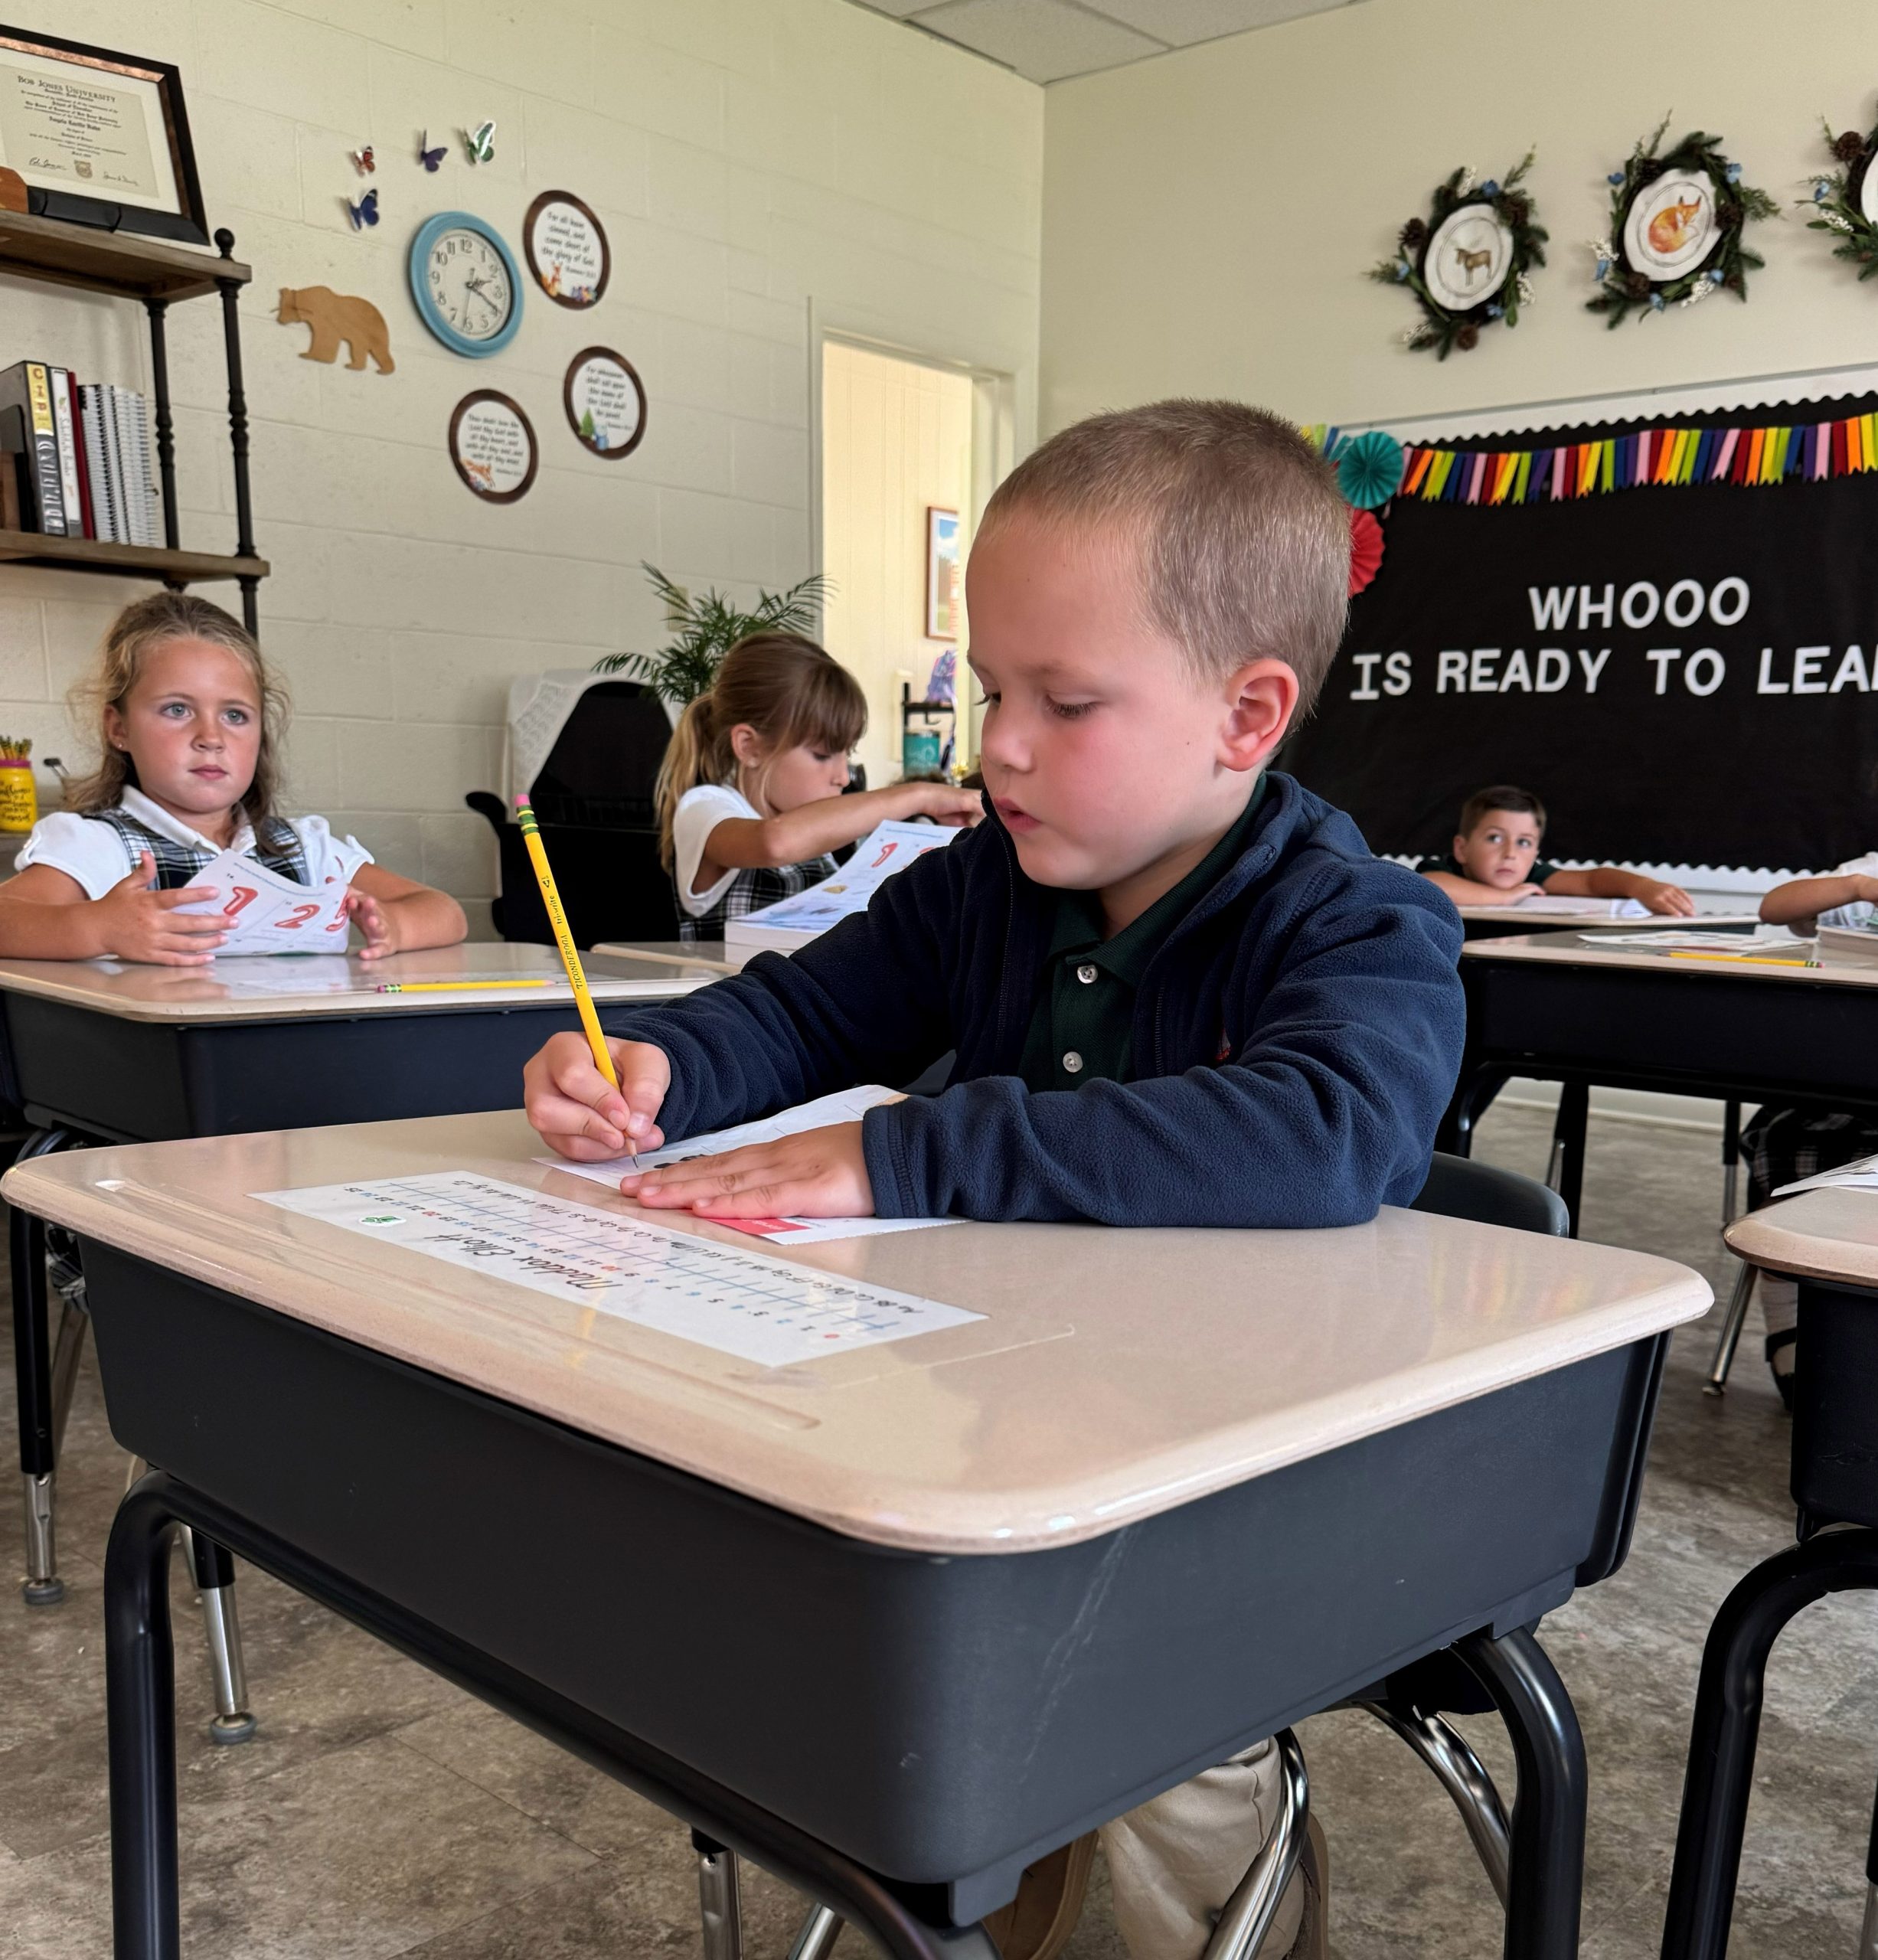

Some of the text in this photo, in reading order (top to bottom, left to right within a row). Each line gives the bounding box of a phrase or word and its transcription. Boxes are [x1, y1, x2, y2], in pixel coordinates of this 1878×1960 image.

[18, 75, 35, 86] BOB
[38, 80, 64, 91] JONES
[65, 85, 116, 103] UNIVERSITY
[436, 251, 448, 266] 10
[447, 240, 456, 255] 11
[460, 238, 472, 253] 12
[1529, 576, 1751, 632] WHOOO
[1350, 645, 1878, 701] IS READY TO LEA
[223, 886, 260, 916] 1
[274, 904, 322, 929] 2
[423, 1233, 623, 1289] Maddox Elliott
